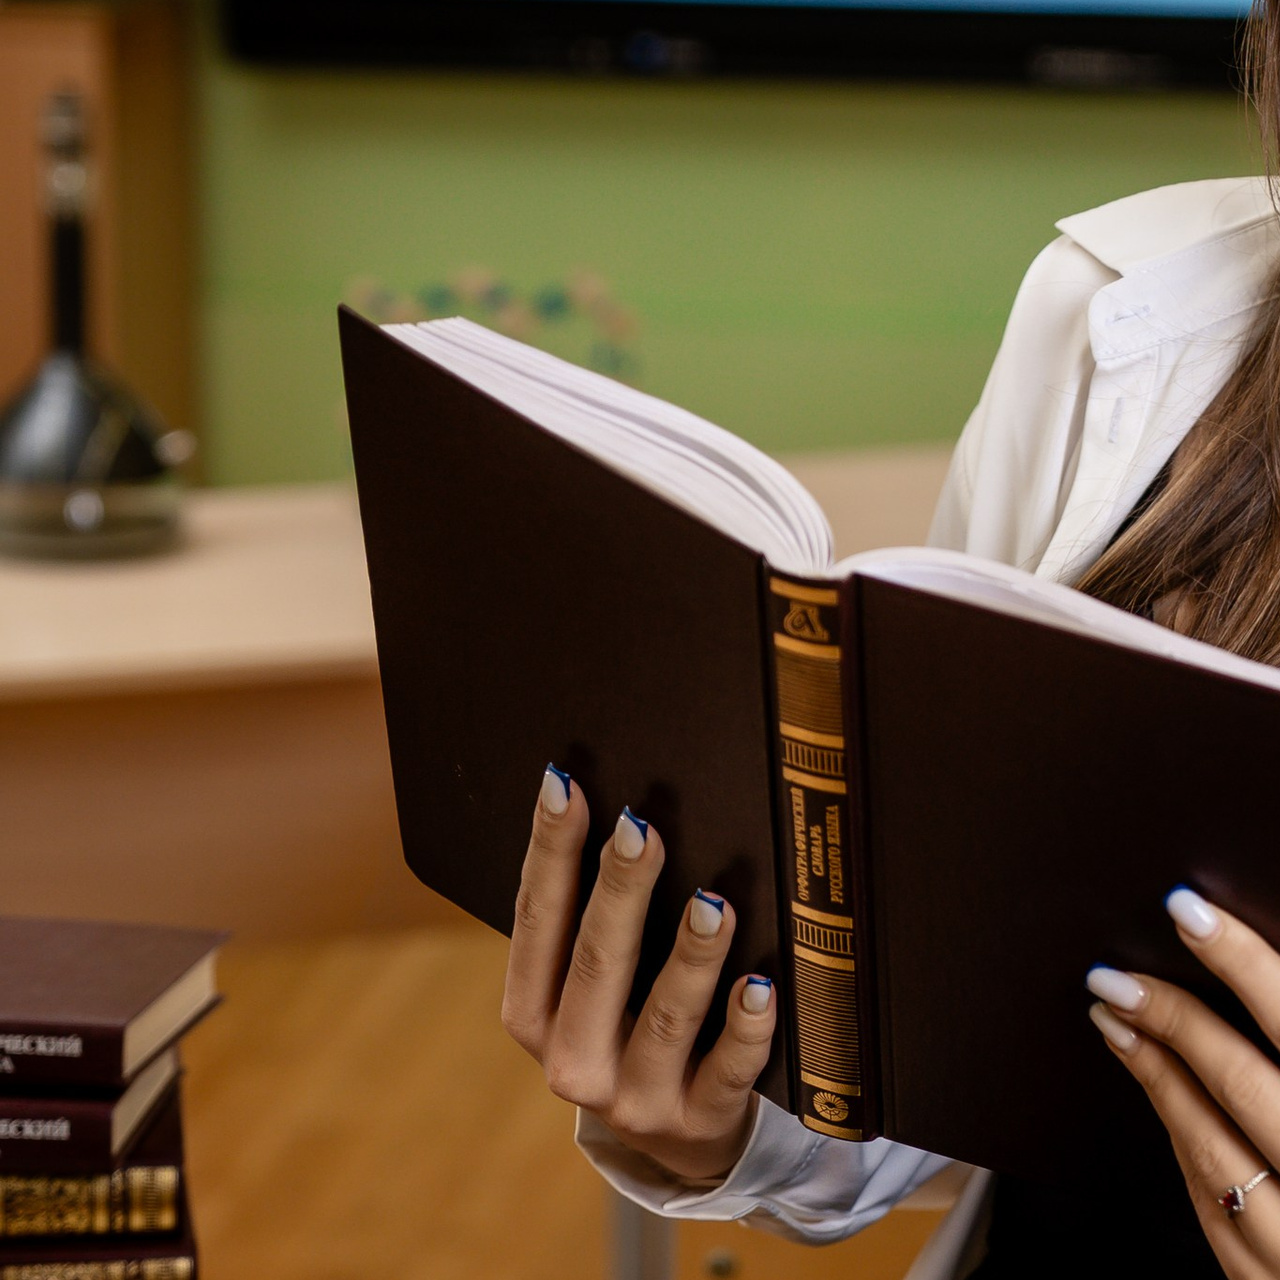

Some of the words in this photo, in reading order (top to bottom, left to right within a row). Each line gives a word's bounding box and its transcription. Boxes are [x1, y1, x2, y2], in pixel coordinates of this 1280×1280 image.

[790, 787, 809, 901] ОРФОГРАФИЧЕСКИЙ
[810, 824, 824, 877] СЛОВАРЬ
[826, 805, 840, 845] ЯЗЫКА
[828, 846, 843, 904] РУССКОГО
